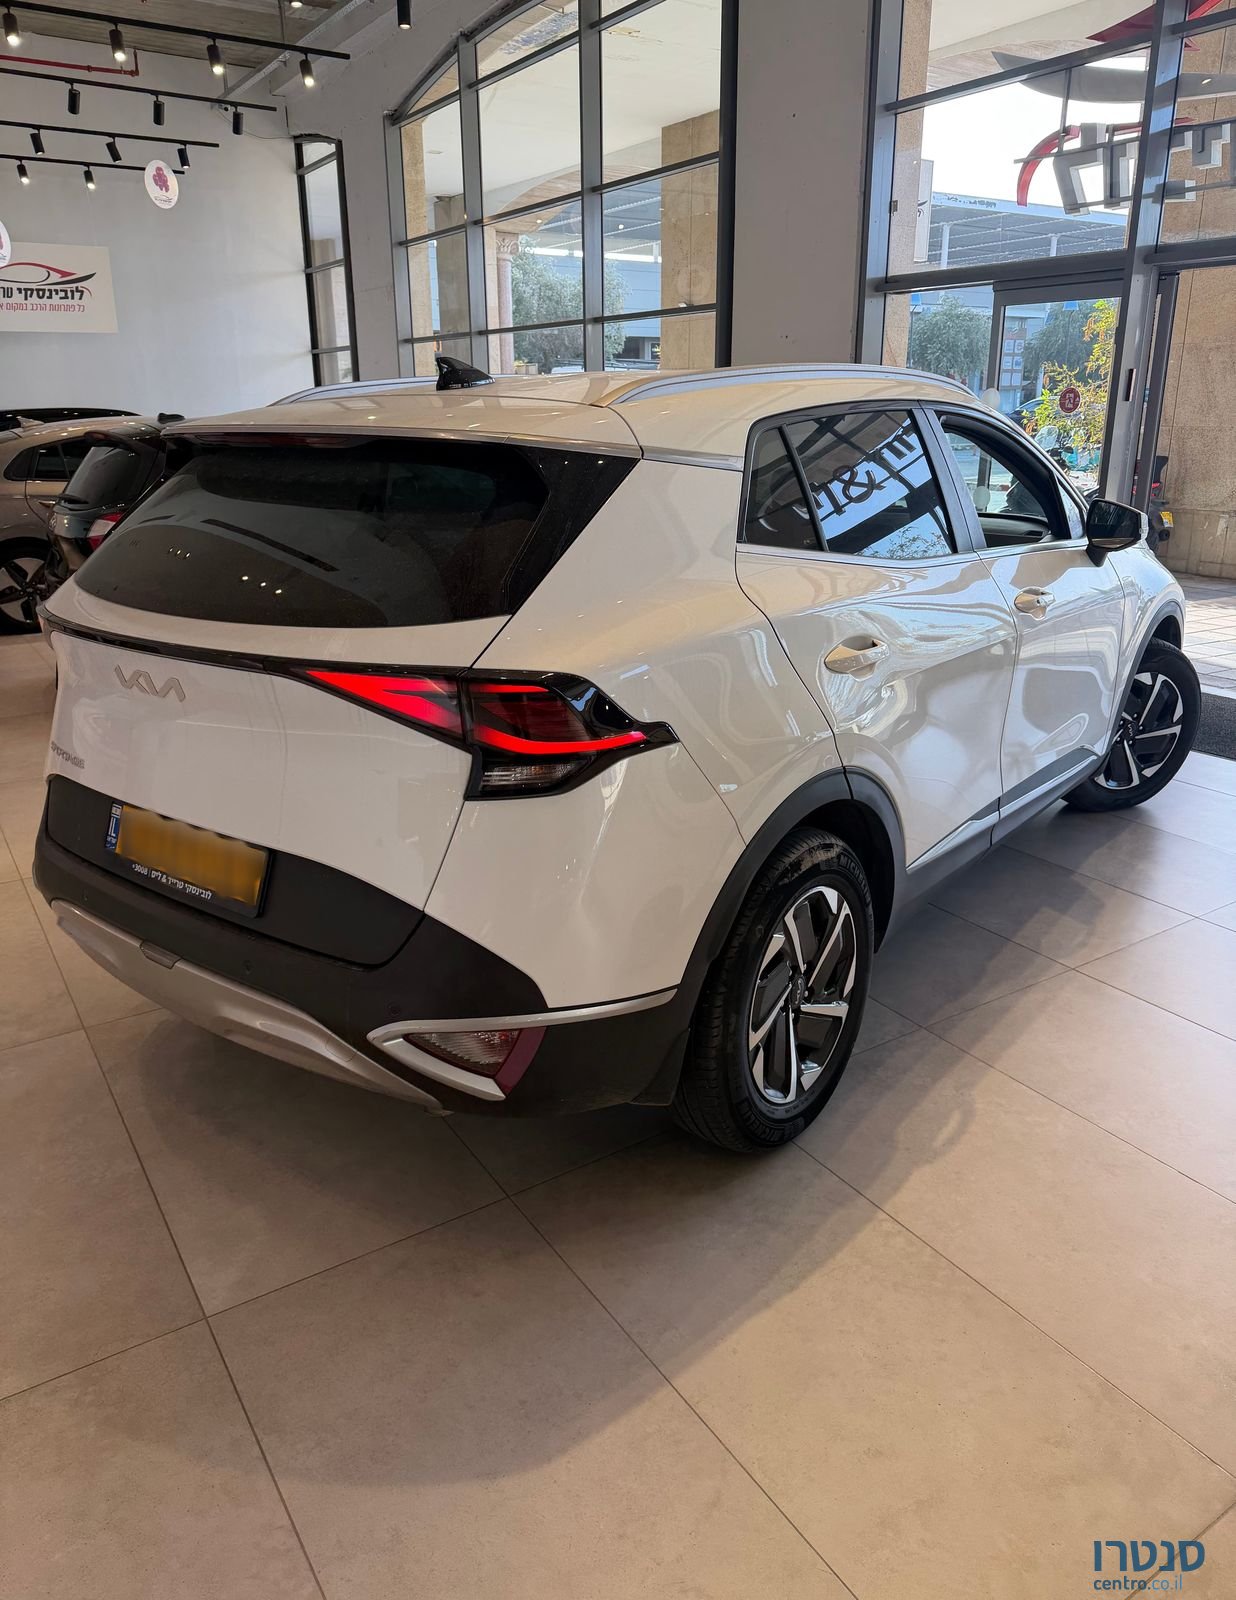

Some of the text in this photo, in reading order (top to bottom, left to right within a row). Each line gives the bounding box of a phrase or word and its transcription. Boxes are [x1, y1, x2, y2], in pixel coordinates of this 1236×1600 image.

[16, 286, 85, 301] לובינסקי
[6, 302, 28, 312] במקום
[30, 302, 47, 312] הרכב
[49, 303, 75, 312] פתרונות
[114, 664, 186, 702] KIA
[185, 882, 212, 900] לובינסקי
